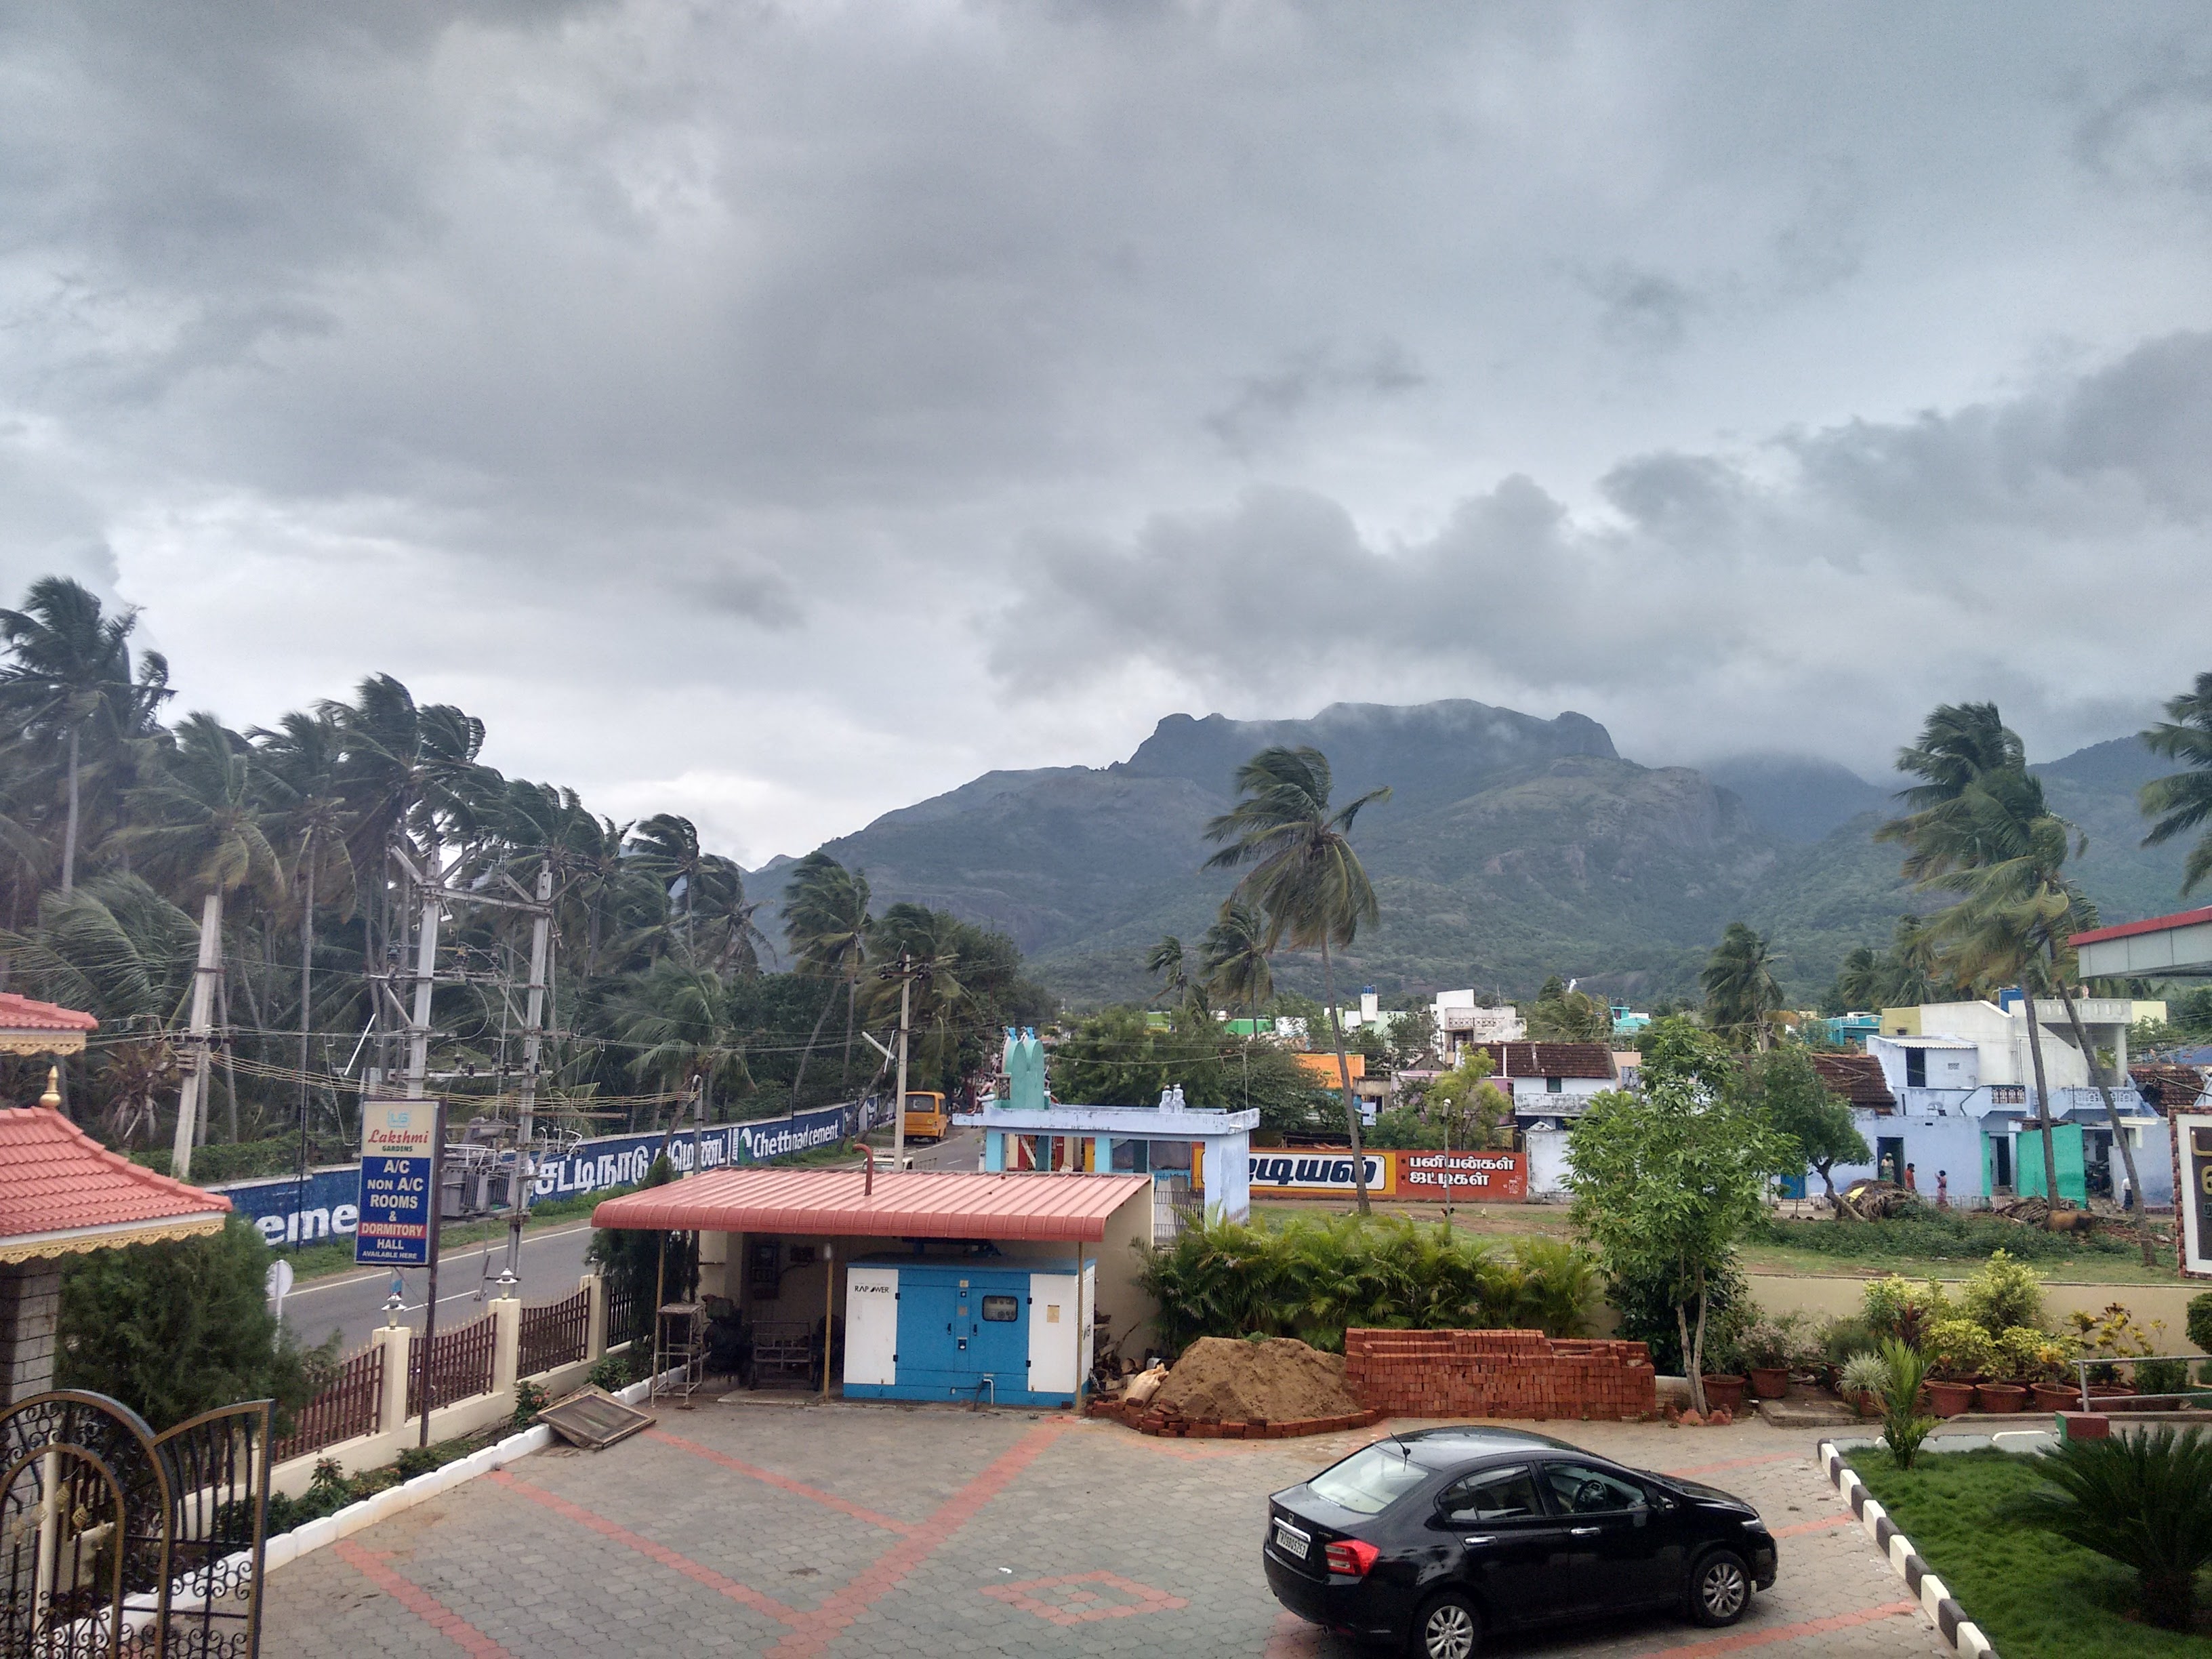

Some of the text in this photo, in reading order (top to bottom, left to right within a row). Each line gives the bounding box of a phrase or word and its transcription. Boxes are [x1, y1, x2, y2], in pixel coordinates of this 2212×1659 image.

[368, 1129, 429, 1143] Lakshmi
[753, 1124, 809, 1158] Chettinad
[808, 1119, 839, 1146] cement
[383, 1160, 410, 1174] A/C
[367, 1177, 424, 1192] NON A/C
[369, 1194, 419, 1209] ROOMS
[388, 1210, 397, 1222] &
[361, 1223, 424, 1237] DORMITORY
[376, 1238, 405, 1250] HALL
[362, 1250, 398, 1258] AVAILABLE
